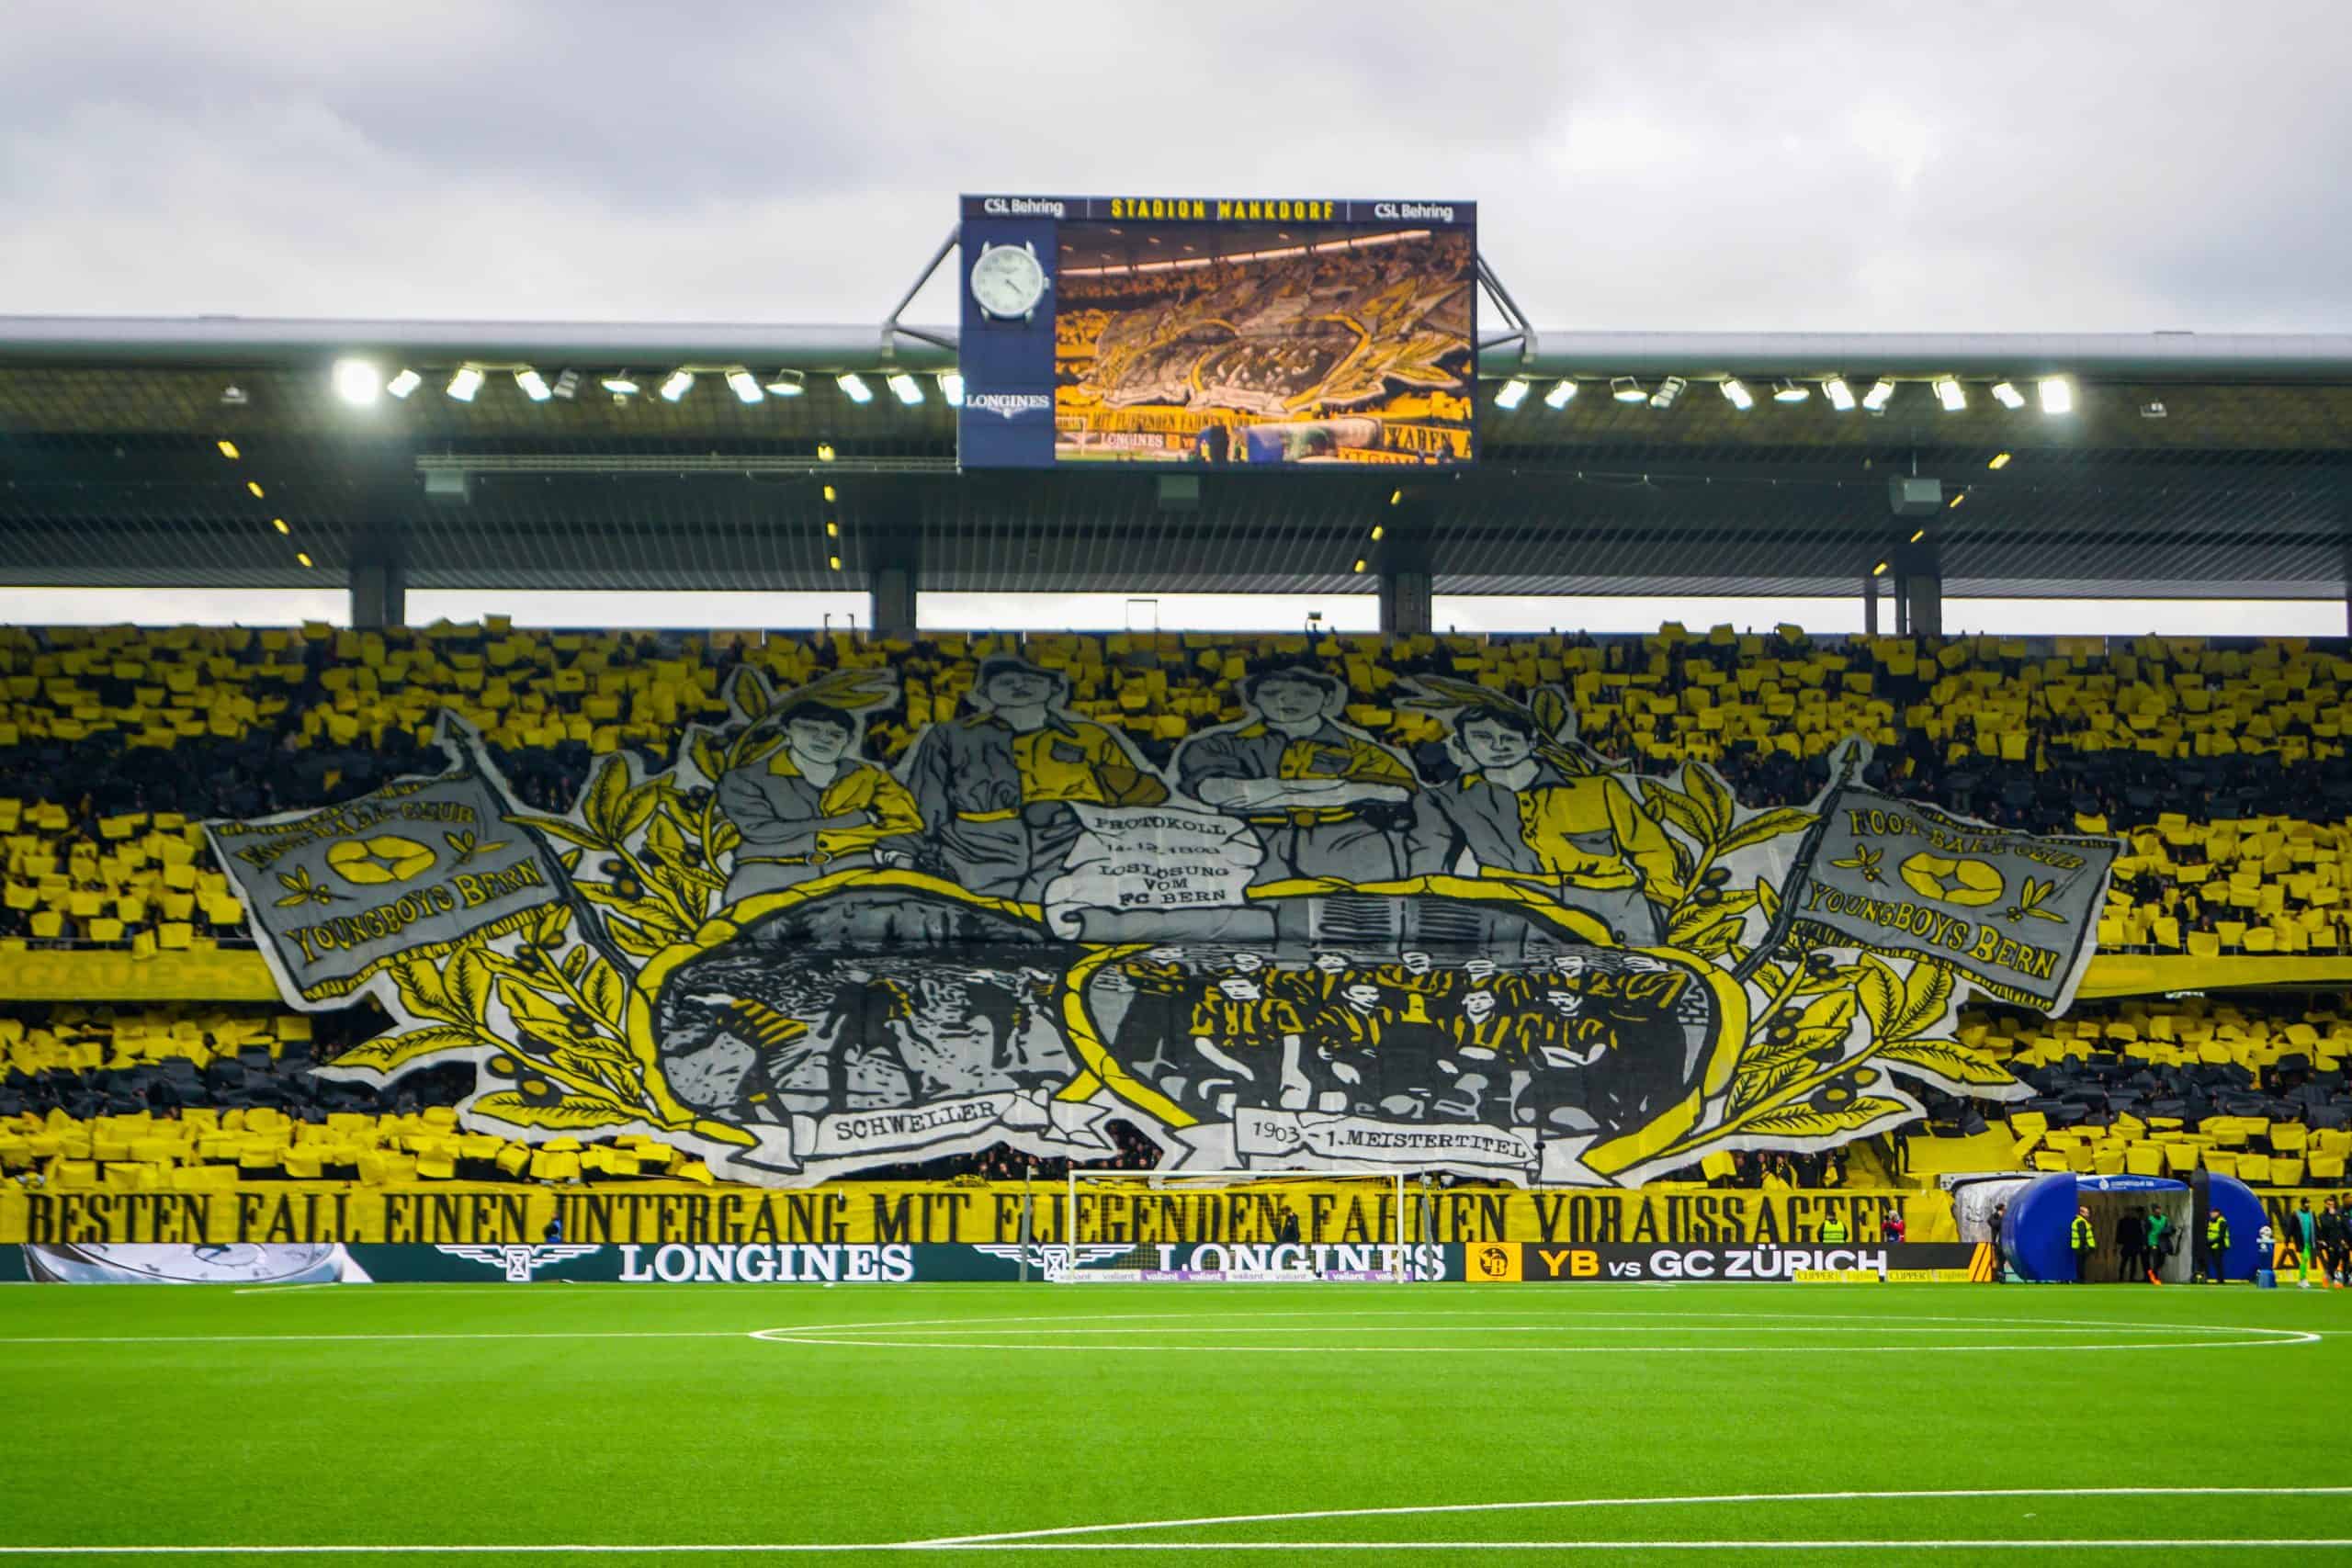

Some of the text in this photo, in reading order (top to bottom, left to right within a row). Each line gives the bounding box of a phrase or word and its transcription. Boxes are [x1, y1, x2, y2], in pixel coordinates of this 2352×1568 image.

[984, 197, 1064, 217] CSL Behring
[1111, 198, 1334, 220] STADION WANKDORF
[1374, 203, 1453, 222] CSL Behring
[966, 394, 1050, 408] LONGINES
[1094, 816, 1227, 835] PROTOKOLL
[450, 856, 548, 909] BERN
[1144, 878, 1188, 891] VOM
[1119, 890, 1226, 906] FC BERN
[1969, 923, 2059, 981] BERN
[837, 1101, 999, 1141] SCHWELLER
[1251, 1121, 1301, 1144] 1903
[23, 1193, 213, 1244] BESTEN
[234, 1193, 362, 1243] FALL
[382, 1193, 533, 1242] EINEN
[553, 1193, 849, 1243] UNTERGANG
[868, 1193, 971, 1242] MIT
[992, 1193, 1288, 1242] FLIEGENDEN
[1308, 1193, 1511, 1242] FAHNEN
[618, 1244, 914, 1282] LONGINES
[1156, 1244, 1446, 1281] LONGINES
[1538, 1244, 1887, 1278] YB vs GC ZÜRICH
